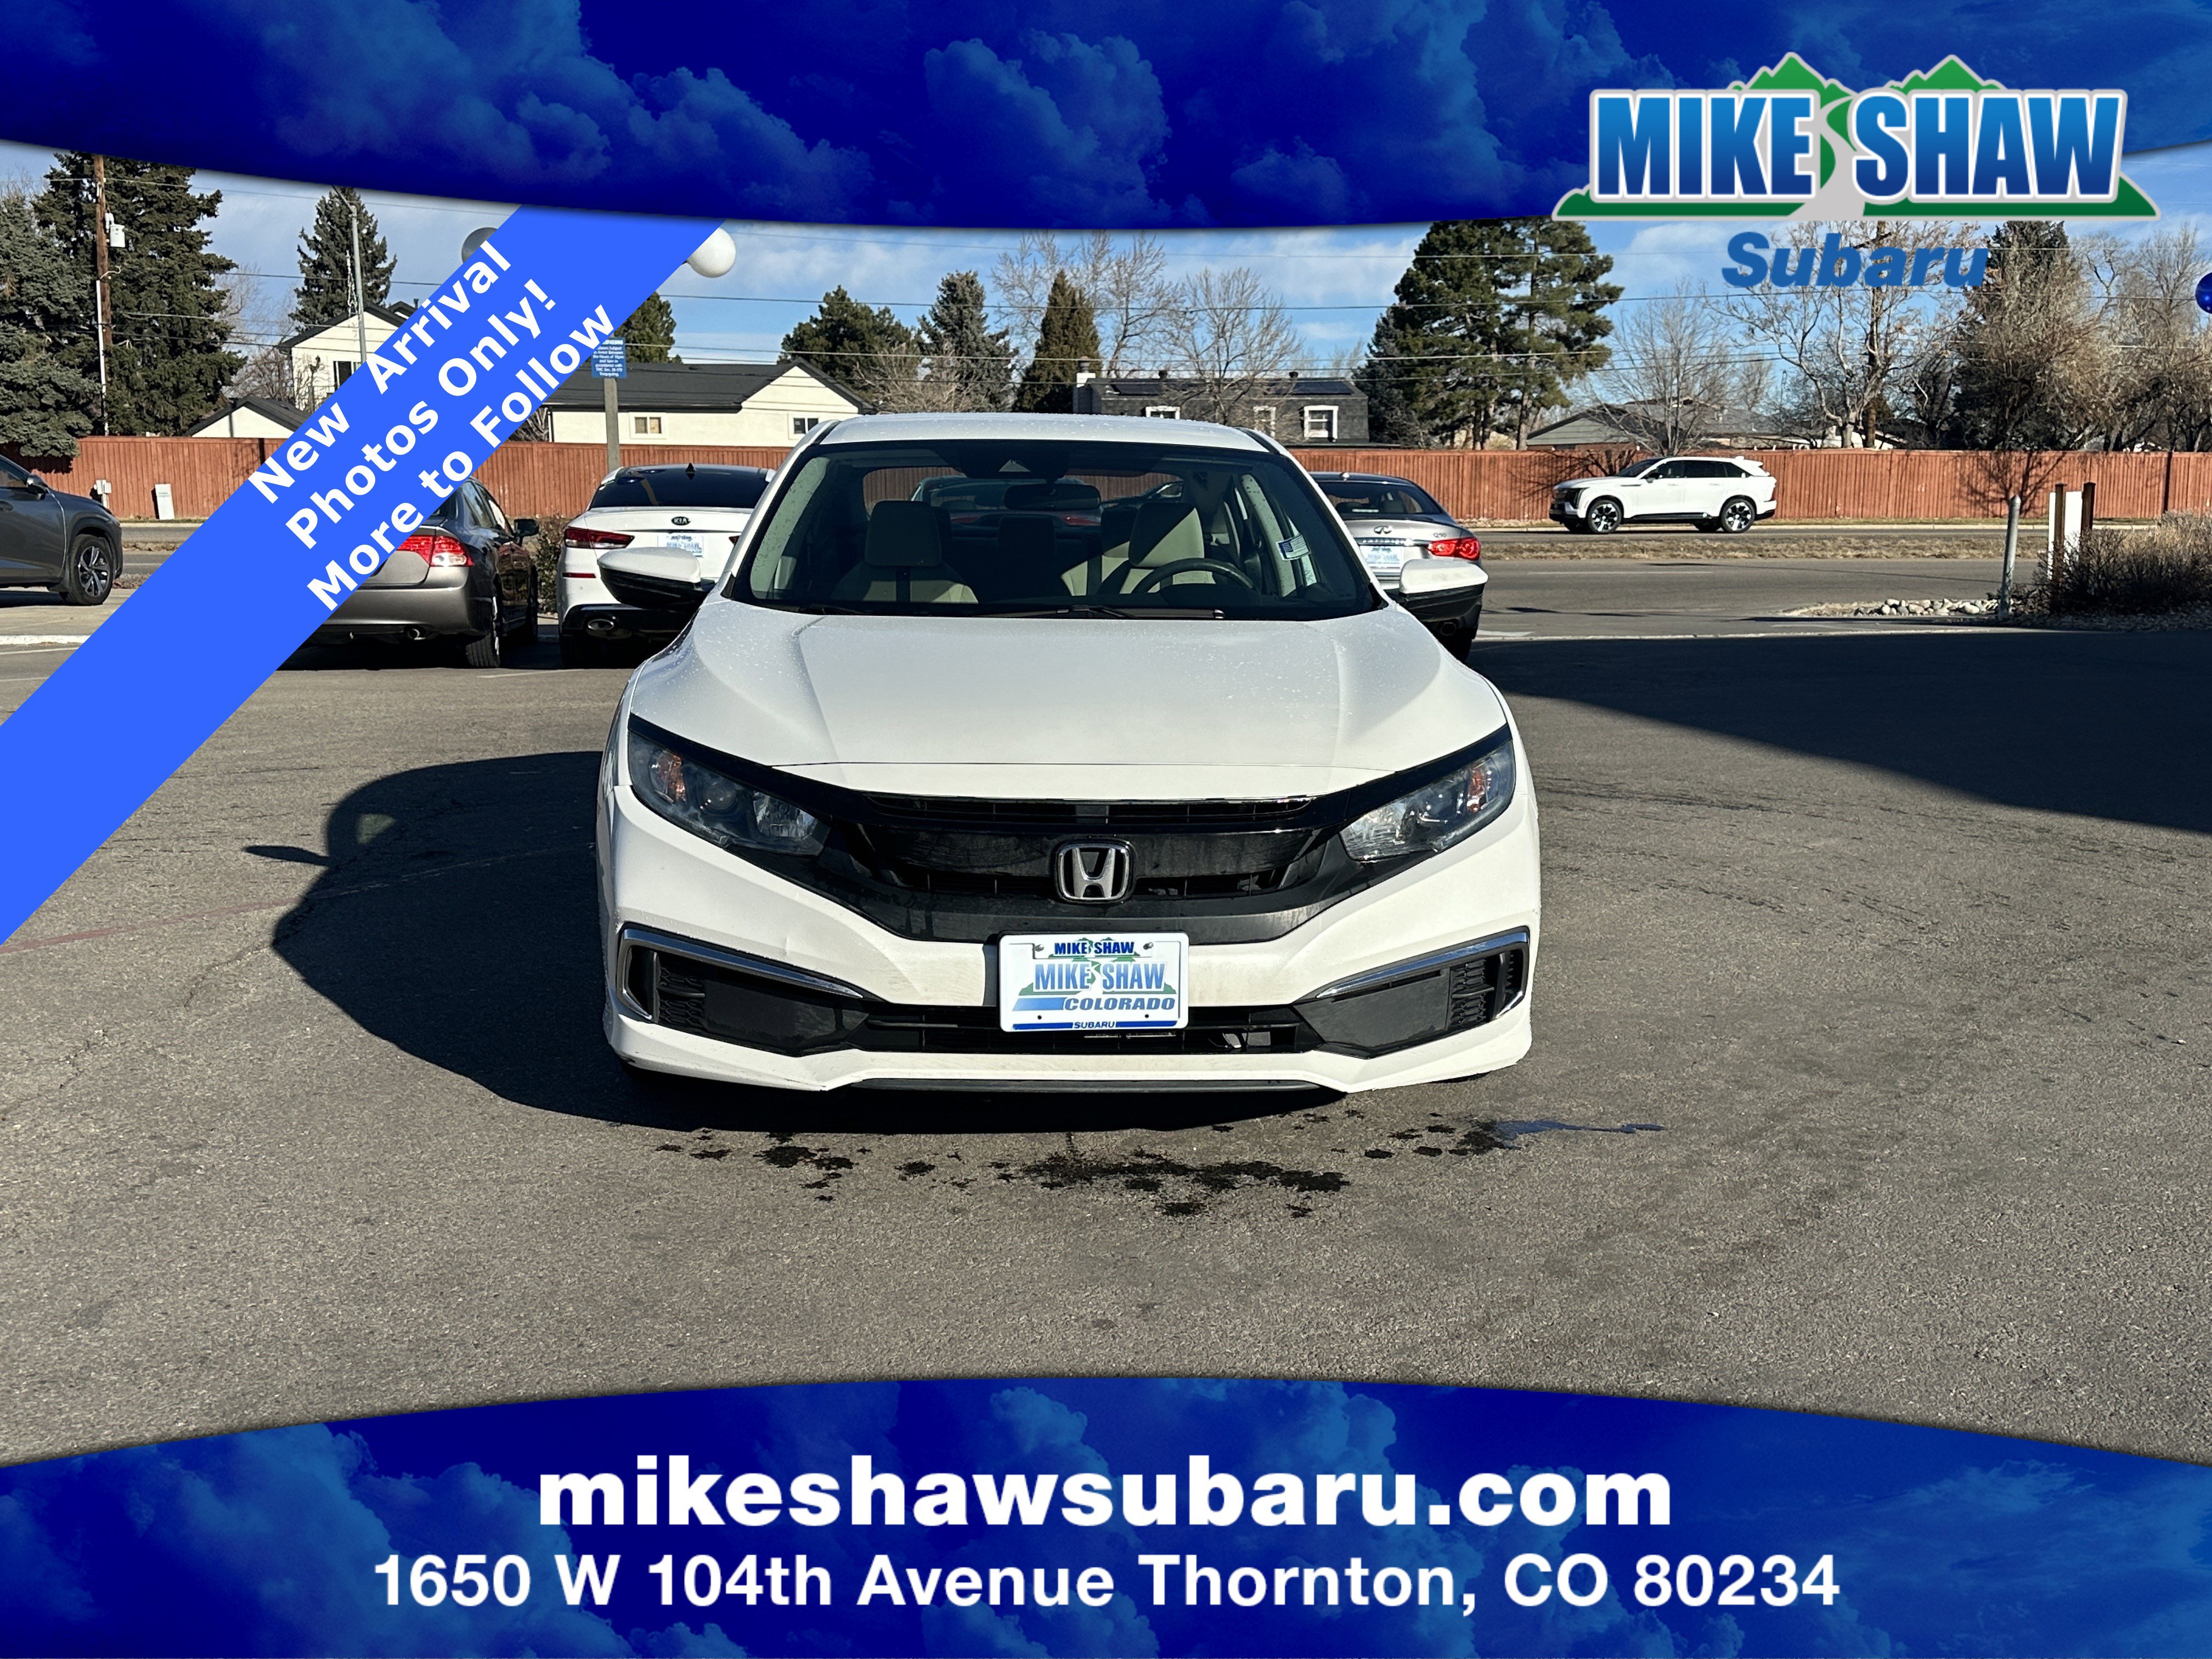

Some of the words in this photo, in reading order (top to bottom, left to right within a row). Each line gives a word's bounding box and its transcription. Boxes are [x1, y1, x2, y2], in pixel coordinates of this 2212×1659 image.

[1054, 942, 1088, 954] MIKE
[1094, 941, 1135, 954] SHAW
[1035, 963, 1091, 990] MIKE
[1102, 963, 1166, 989] SHAW
[1064, 997, 1176, 1011] COLORADO
